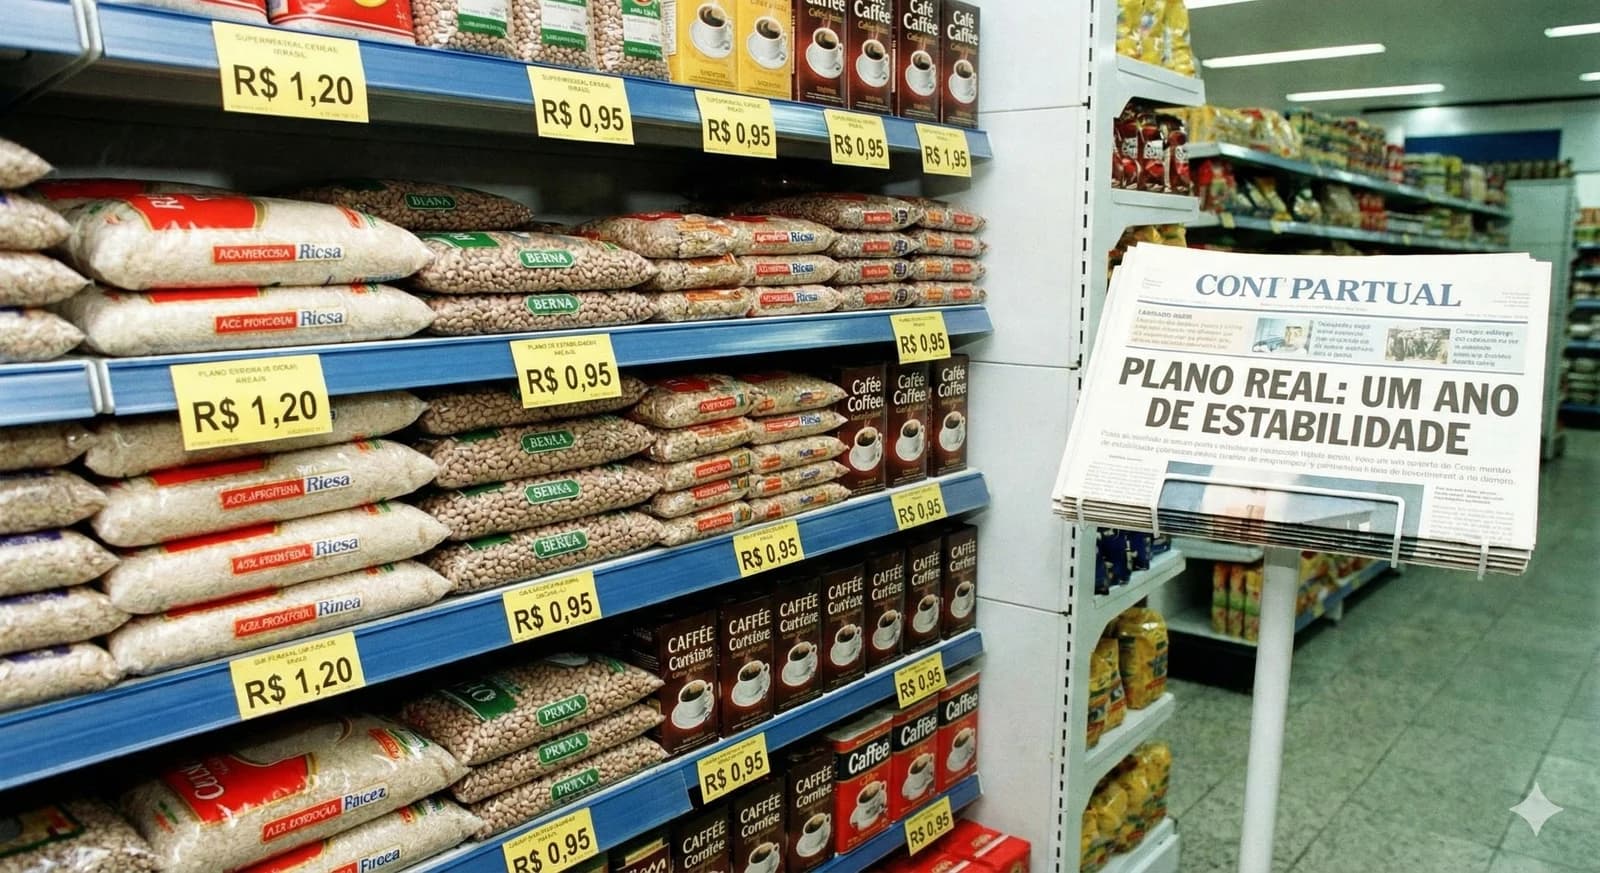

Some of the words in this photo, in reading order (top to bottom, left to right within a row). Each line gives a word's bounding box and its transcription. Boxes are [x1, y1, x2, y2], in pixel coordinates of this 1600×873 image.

[953, 10, 974, 29] Café
[234, 65, 277, 101] R$
[291, 72, 353, 107] 1,20
[542, 99, 572, 129] R$
[580, 104, 623, 133] 0,95
[708, 119, 731, 144] R$
[736, 122, 770, 148] 0,95
[834, 134, 852, 157] R$
[857, 138, 883, 160] 0,95
[925, 146, 940, 166] R$
[944, 149, 967, 169] 1,95
[299, 243, 342, 260] Ricsa
[525, 251, 567, 265] BERNA
[534, 297, 573, 310] BERNA
[1289, 277, 1462, 307] PARTUAL
[300, 310, 343, 326] Ricsa
[898, 334, 917, 355] R$
[920, 333, 944, 353] 0,95
[527, 367, 558, 394] R$
[565, 362, 611, 392] 0,95
[1118, 356, 1234, 395] PLANO
[1244, 367, 1347, 405] REAL:
[1361, 375, 1422, 410] UM
[1433, 381, 1519, 418] ANO
[193, 397, 239, 432] R$
[252, 391, 317, 428] 1,20
[1145, 397, 1194, 431] DE
[1201, 402, 1471, 456] ESTABILIDADE
[306, 474, 350, 493] Riesa
[896, 506, 915, 525] R$
[917, 497, 942, 520] 0,95
[315, 538, 358, 556] Riesa
[741, 547, 762, 570] R$
[766, 538, 798, 564] 0,95
[828, 574, 863, 600] CAFFÉE
[514, 605, 545, 635] R$
[550, 592, 594, 625] 0,95
[779, 592, 818, 617] CAFFÉE
[728, 607, 771, 635] CAFFÉE
[667, 623, 714, 654] CAFFÉE
[245, 674, 287, 710] R$
[296, 657, 353, 696] 1,20
[900, 679, 916, 700] R$
[917, 667, 942, 691] 0,95
[705, 768, 728, 796] R$
[731, 751, 764, 782] 0,95
[796, 765, 833, 795] CAFFÉE
[740, 792, 781, 824] CAFFÉE
[682, 819, 726, 854] CAFFÉE
[908, 826, 926, 849] R$
[927, 812, 950, 838] 0,95
[513, 849, 542, 873] R$
[548, 828, 591, 865] 0,95
